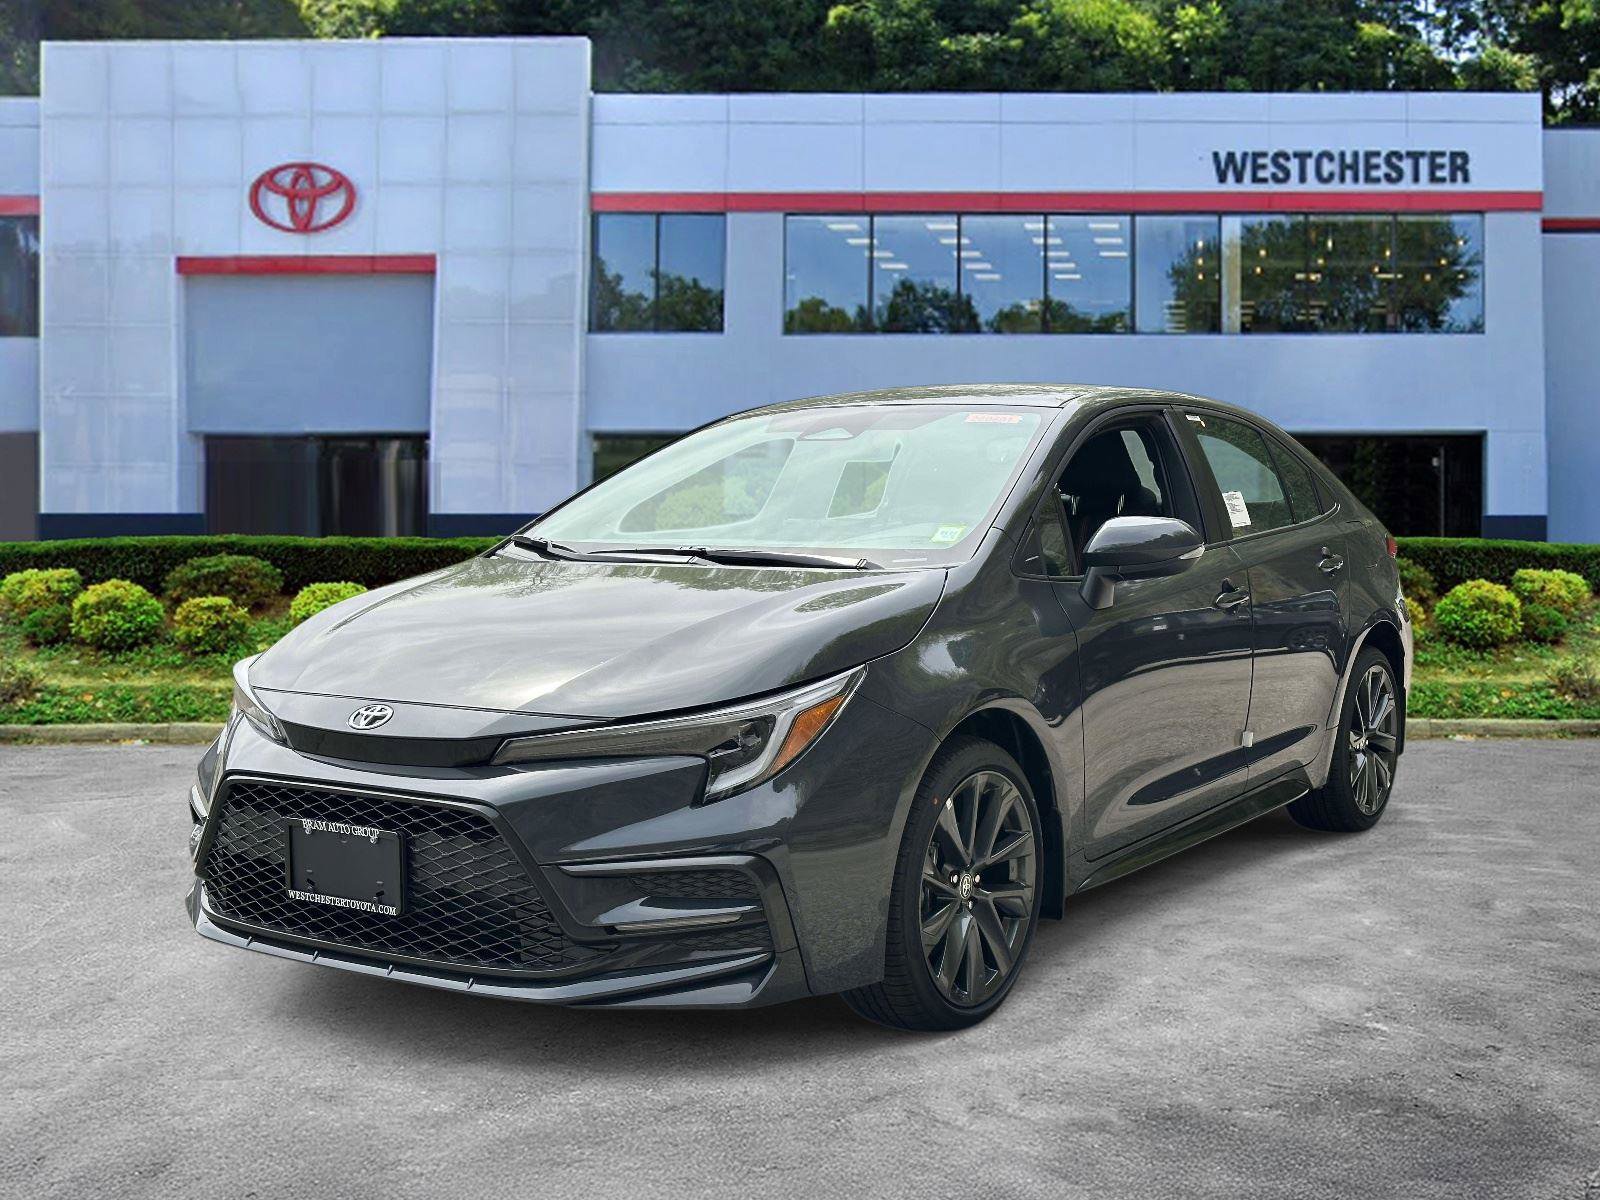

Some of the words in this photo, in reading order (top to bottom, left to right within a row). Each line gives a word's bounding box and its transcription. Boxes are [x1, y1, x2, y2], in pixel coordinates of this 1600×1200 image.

[1212, 150, 1471, 185] WESTCHESTER
[302, 819, 327, 831] BRAM
[328, 822, 351, 834] AUTO
[351, 825, 380, 838] GROUP
[288, 889, 397, 915] WESTCHESTERTOYOTA.COM
